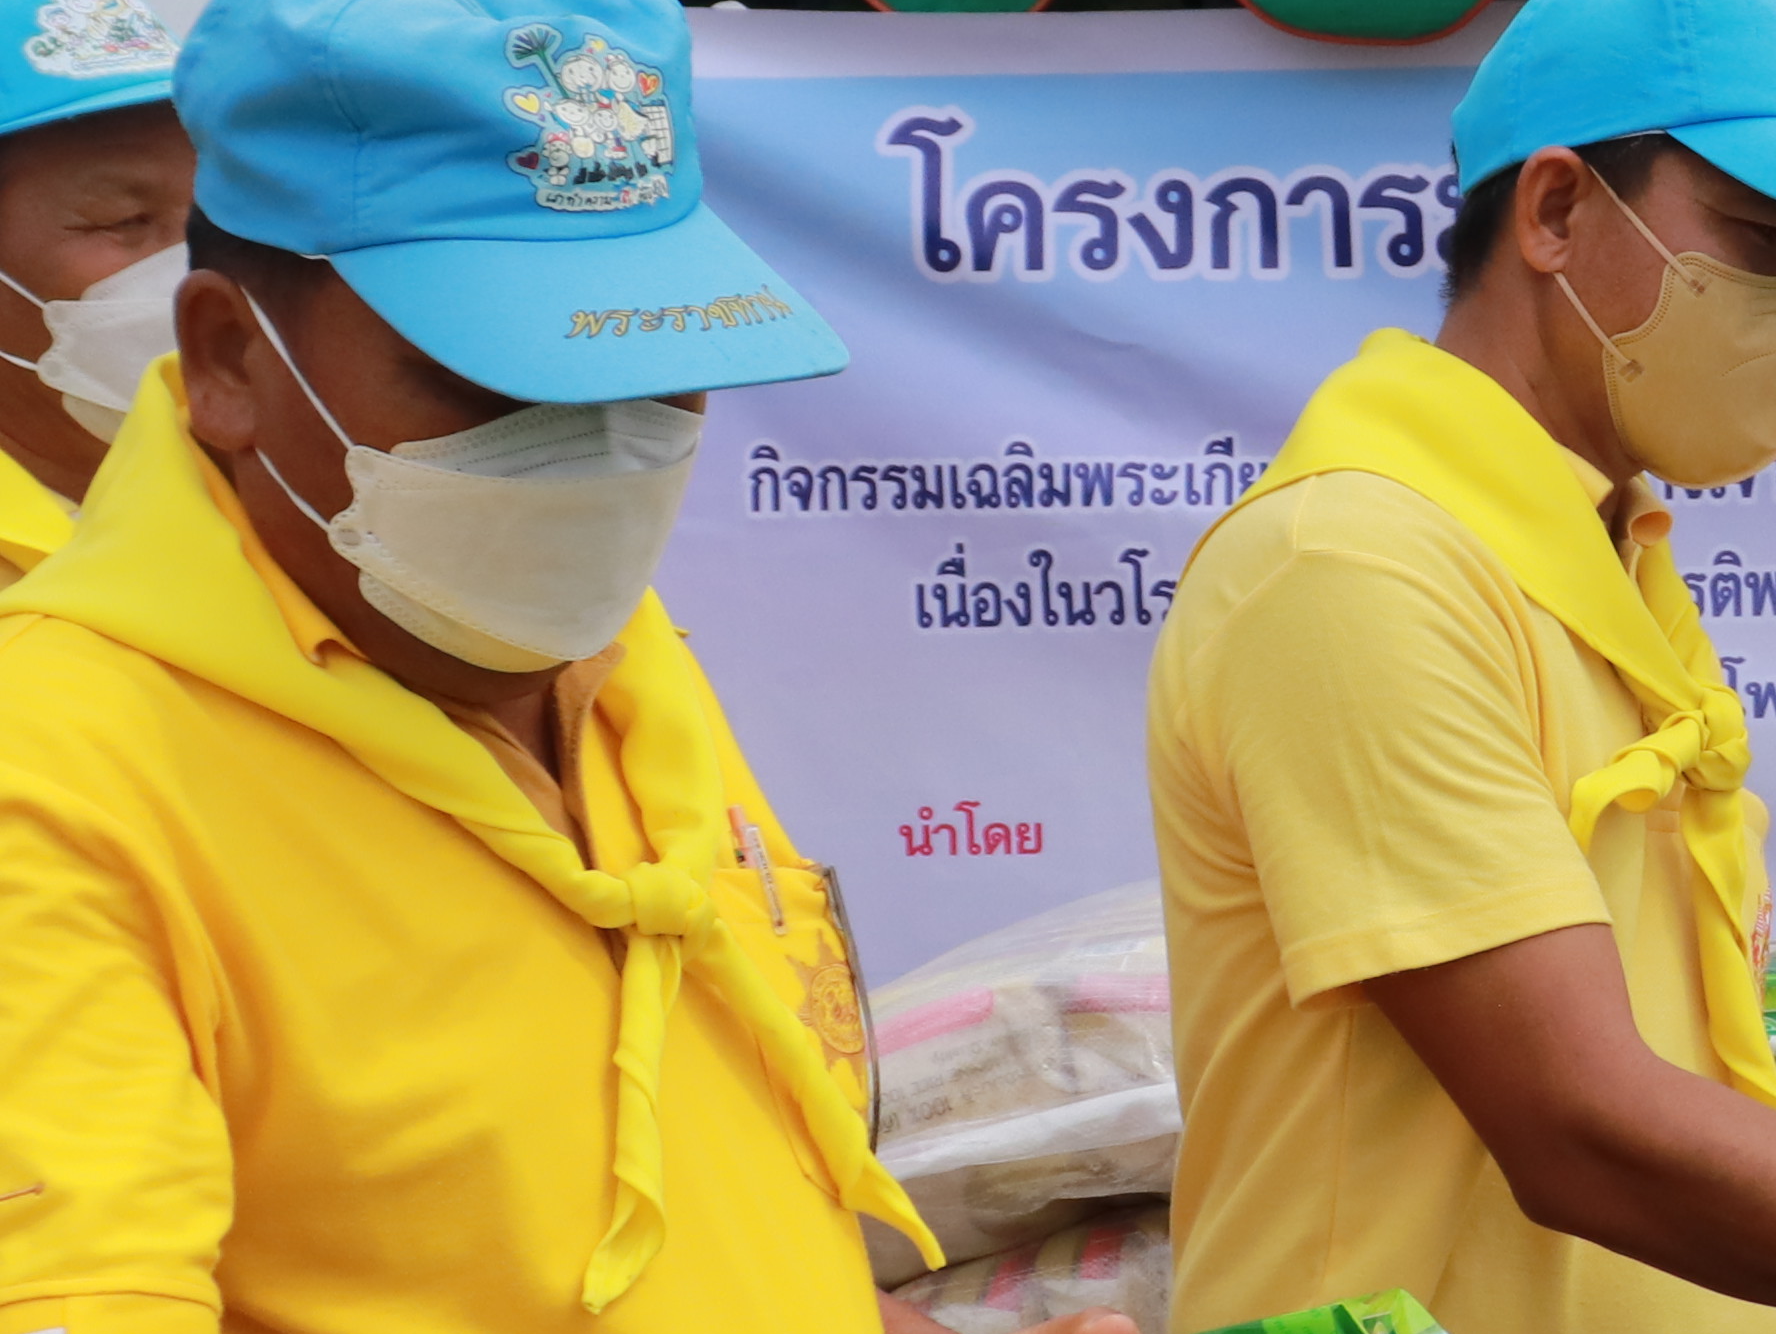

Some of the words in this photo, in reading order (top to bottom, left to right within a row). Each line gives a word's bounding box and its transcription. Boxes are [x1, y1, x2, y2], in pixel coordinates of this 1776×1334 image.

[887, 116, 1459, 272] โครงการ
[900, 801, 1043, 858] นำโดย
